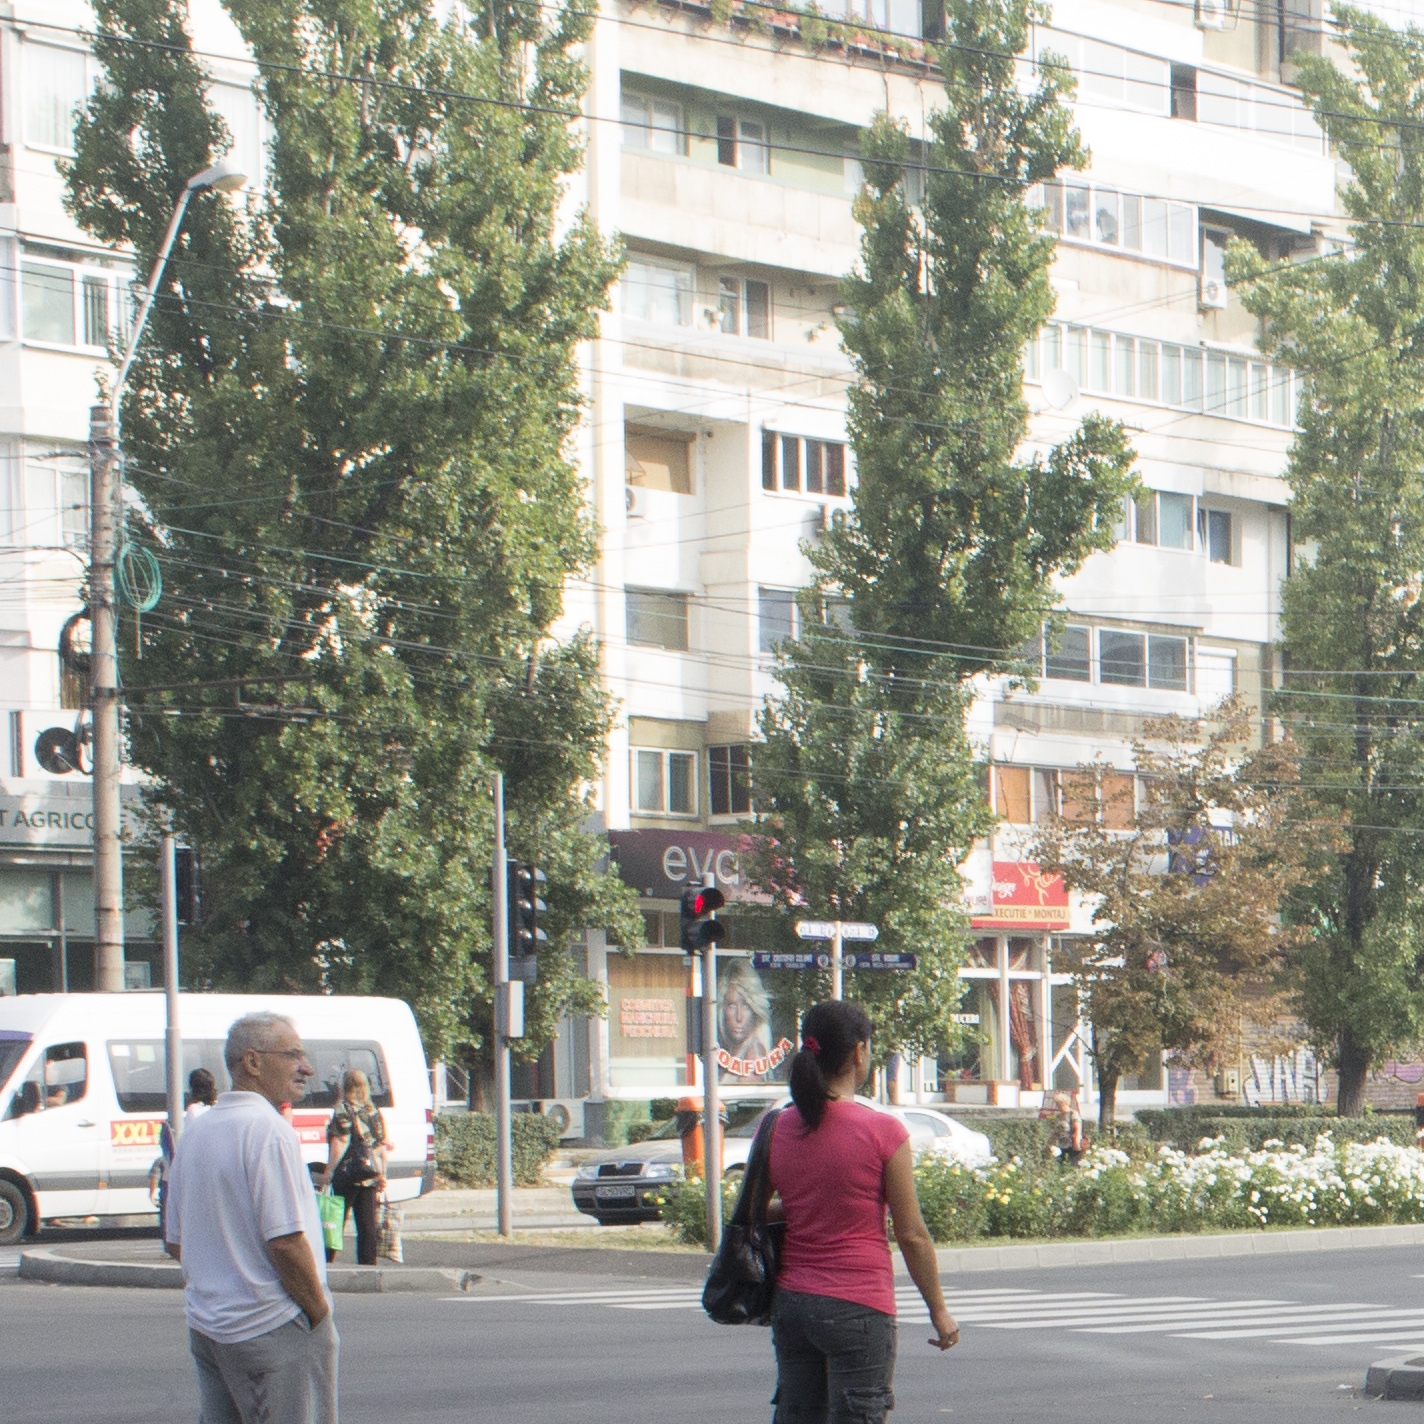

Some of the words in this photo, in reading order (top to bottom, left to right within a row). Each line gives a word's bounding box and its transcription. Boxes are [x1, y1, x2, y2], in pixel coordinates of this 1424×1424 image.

[993, 907, 1028, 919] XECUTIE
[1033, 908, 1067, 920] MONTAJ
[716, 1037, 795, 1077] OAFURA
